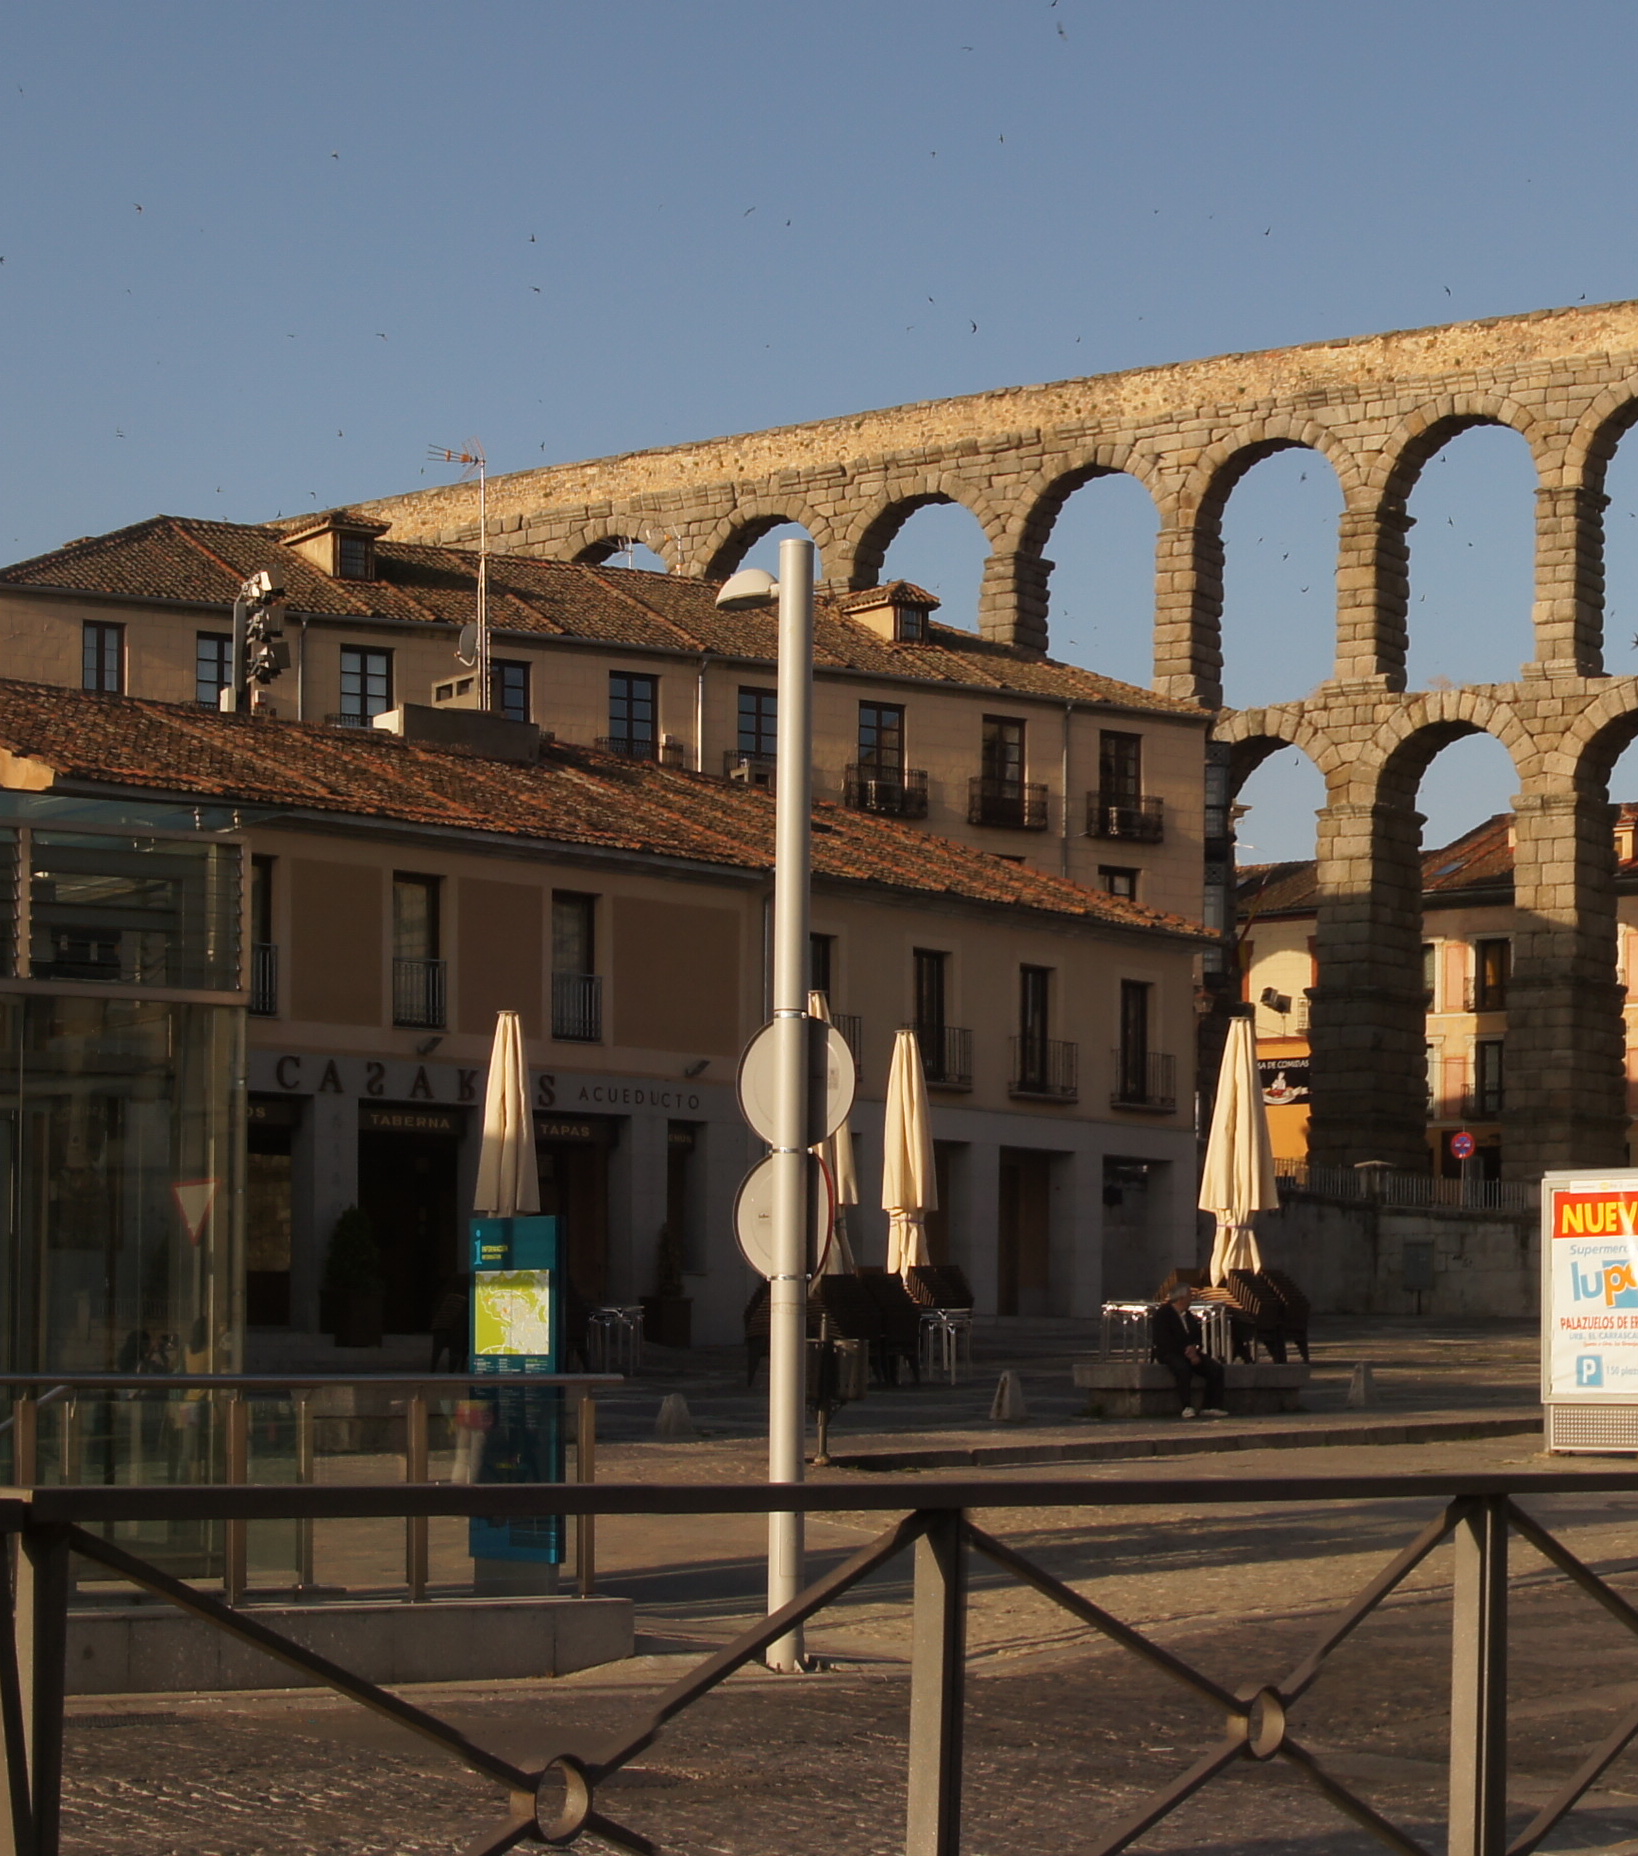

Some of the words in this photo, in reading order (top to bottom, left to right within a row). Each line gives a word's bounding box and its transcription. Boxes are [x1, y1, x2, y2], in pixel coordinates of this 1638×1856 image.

[276, 1055, 555, 1108] CASARS
[579, 1086, 700, 1110] ACUEDUCTO
[371, 1114, 450, 1128] TABERNA
[541, 1124, 590, 1137] TAPAS
[1561, 1316, 1615, 1330] PALAZUELOS
[1617, 1316, 1628, 1329] DE
[1606, 1366, 1620, 1376] 150
